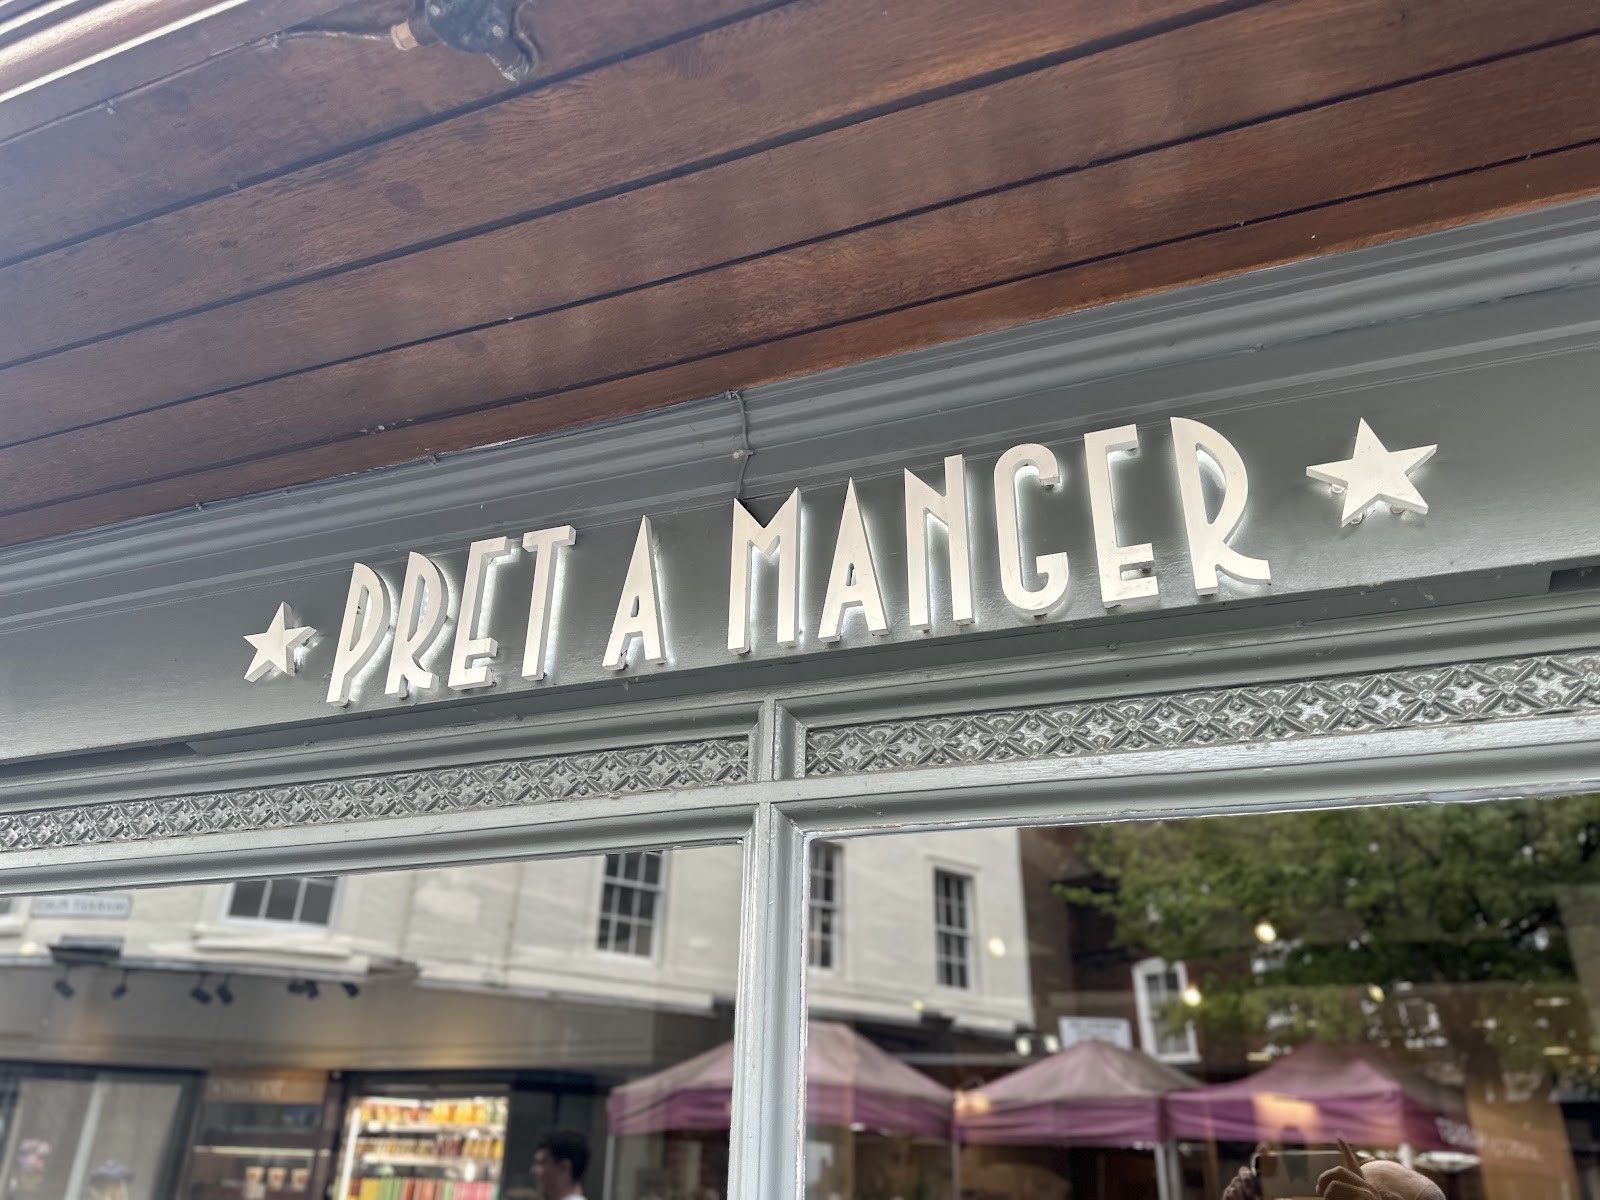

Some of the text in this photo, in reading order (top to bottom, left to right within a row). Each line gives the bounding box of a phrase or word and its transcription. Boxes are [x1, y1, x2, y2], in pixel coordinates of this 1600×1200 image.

[326, 416, 1271, 707] PRET A MANGER
